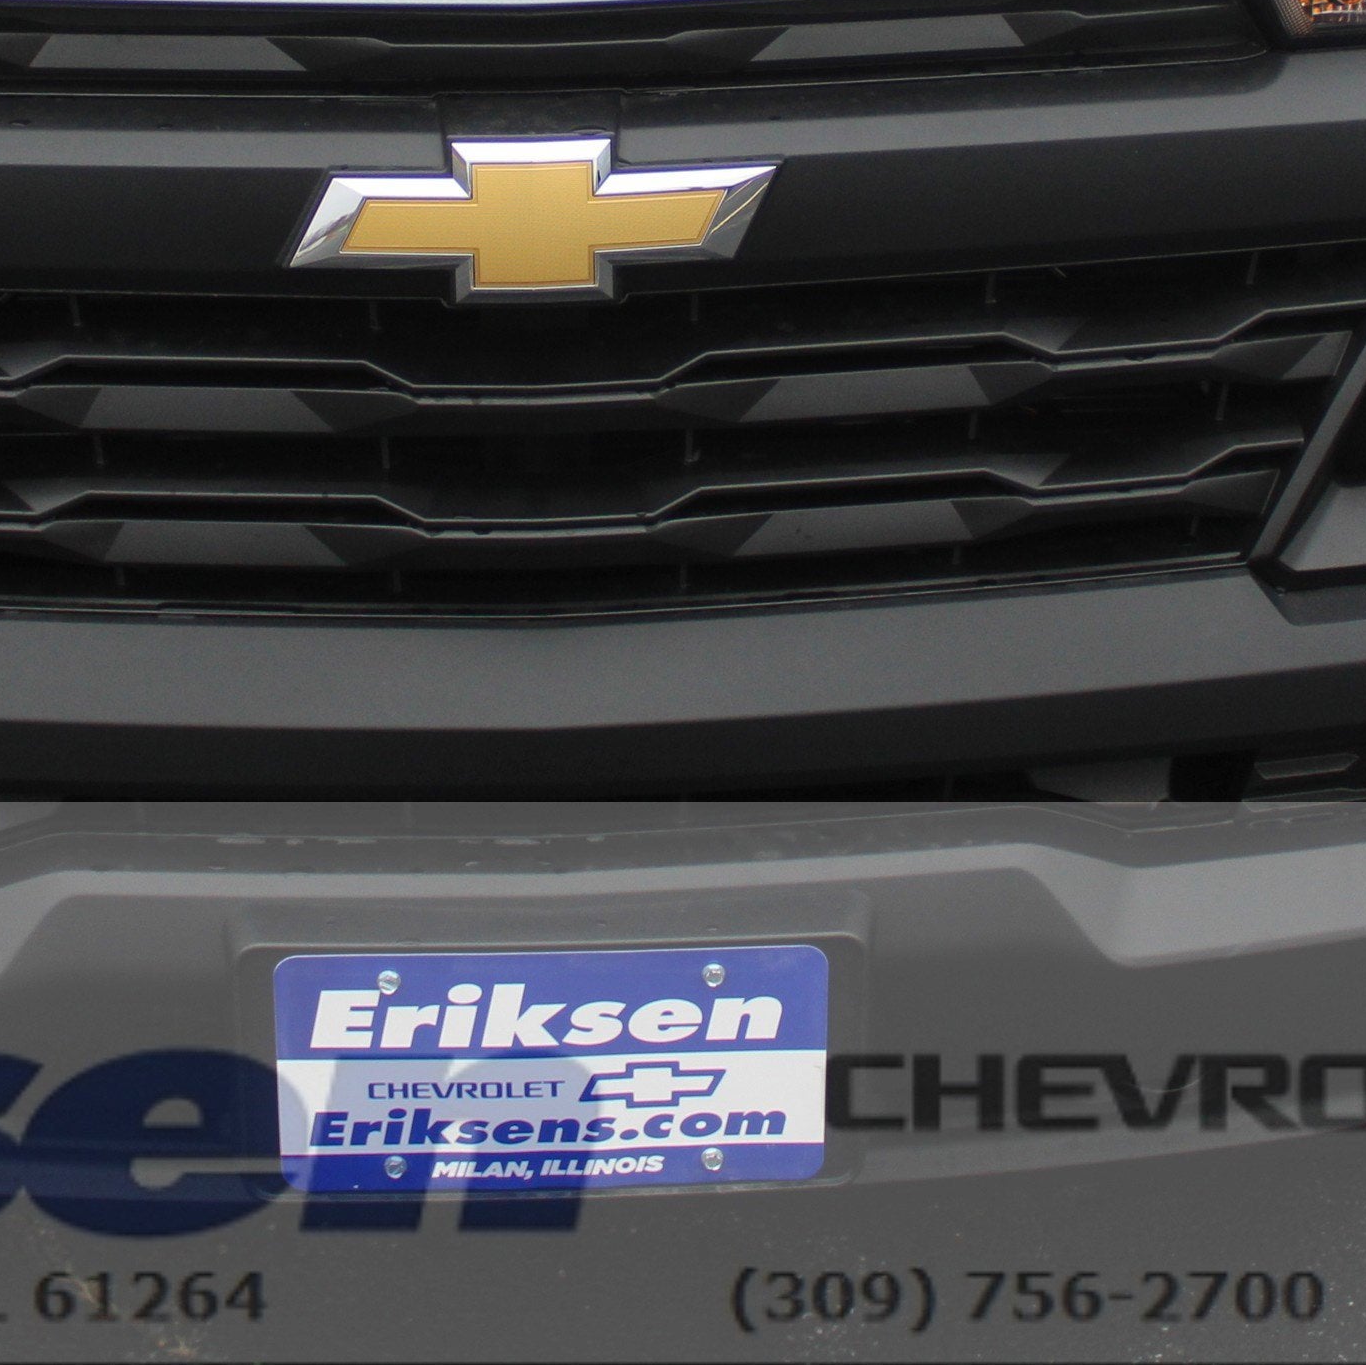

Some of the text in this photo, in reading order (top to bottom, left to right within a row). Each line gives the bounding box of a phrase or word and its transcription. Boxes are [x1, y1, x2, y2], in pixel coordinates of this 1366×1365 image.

[309, 983, 783, 1049] Eriksen
[367, 1079, 566, 1100] CHEVROLET
[309, 1108, 787, 1148] Eriksens.com
[431, 1154, 665, 1180] MILAN, ILLINOIS
